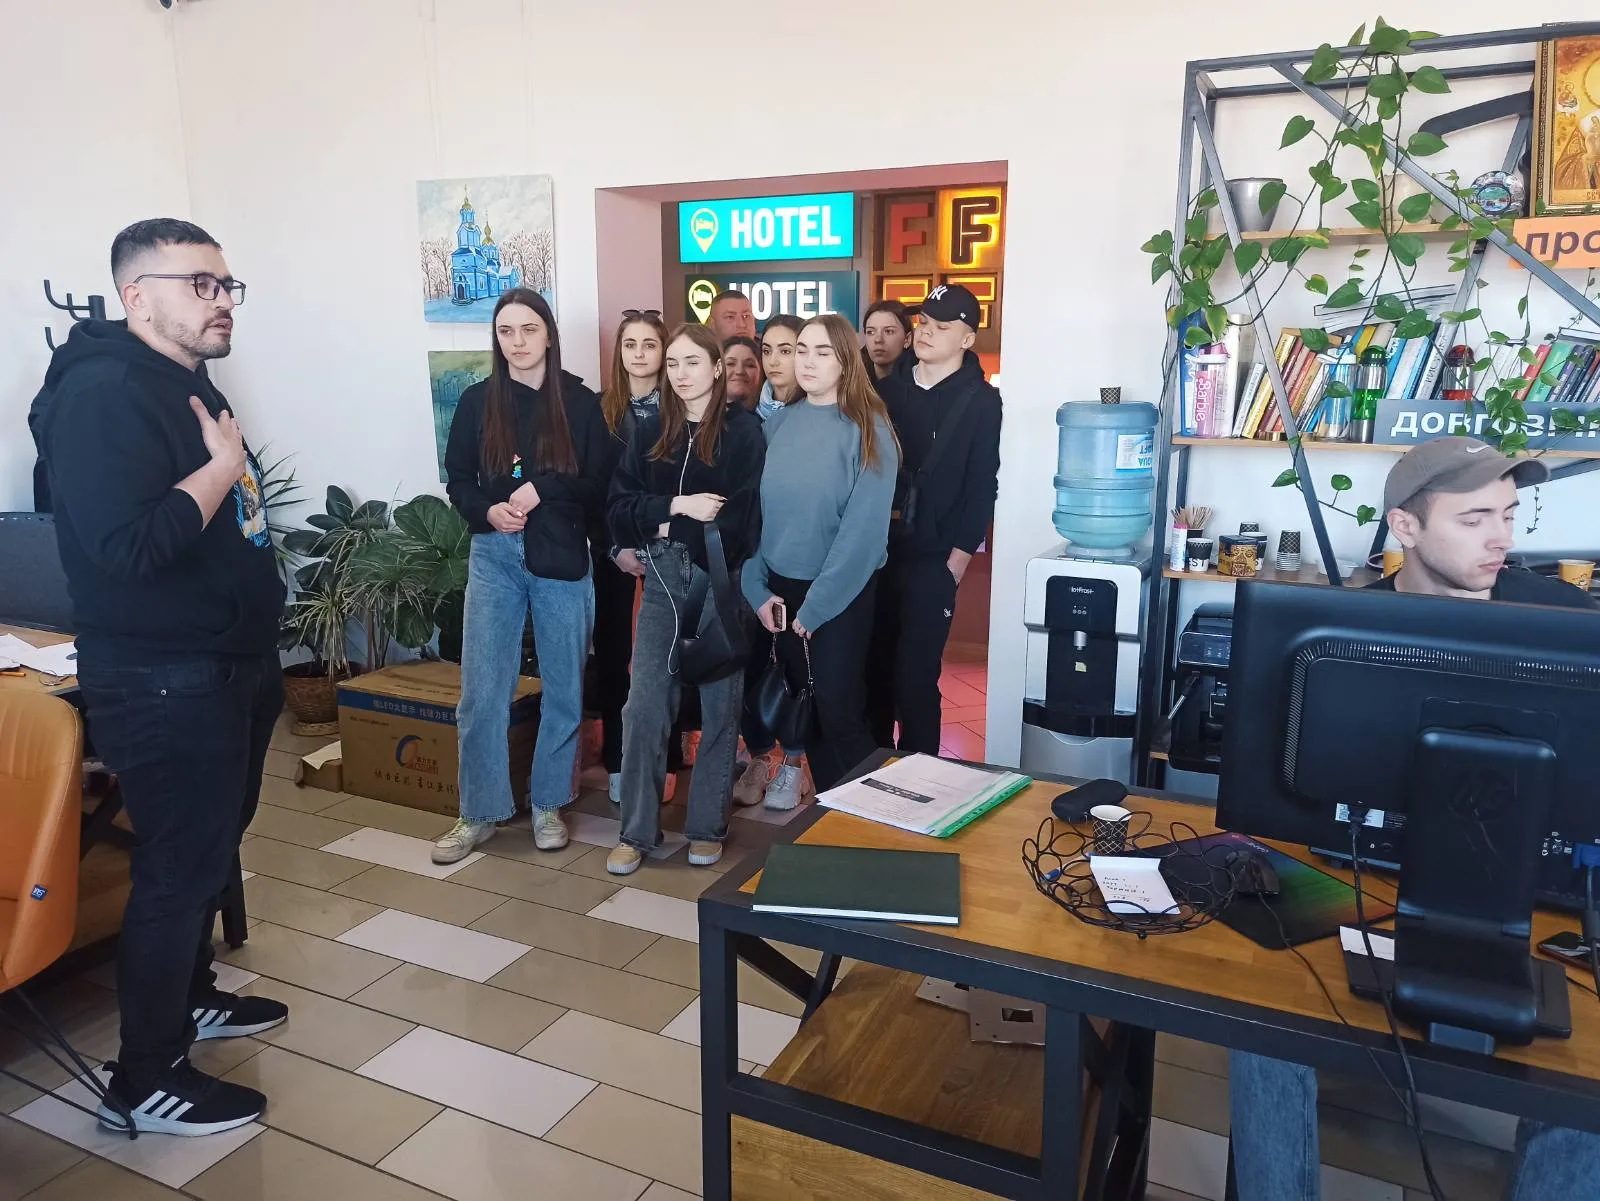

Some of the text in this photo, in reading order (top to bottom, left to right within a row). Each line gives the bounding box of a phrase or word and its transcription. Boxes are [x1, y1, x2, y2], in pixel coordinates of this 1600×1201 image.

[731, 204, 842, 249] HOTEL
[951, 195, 1000, 265] F
[1195, 377, 1212, 422] Barbie
